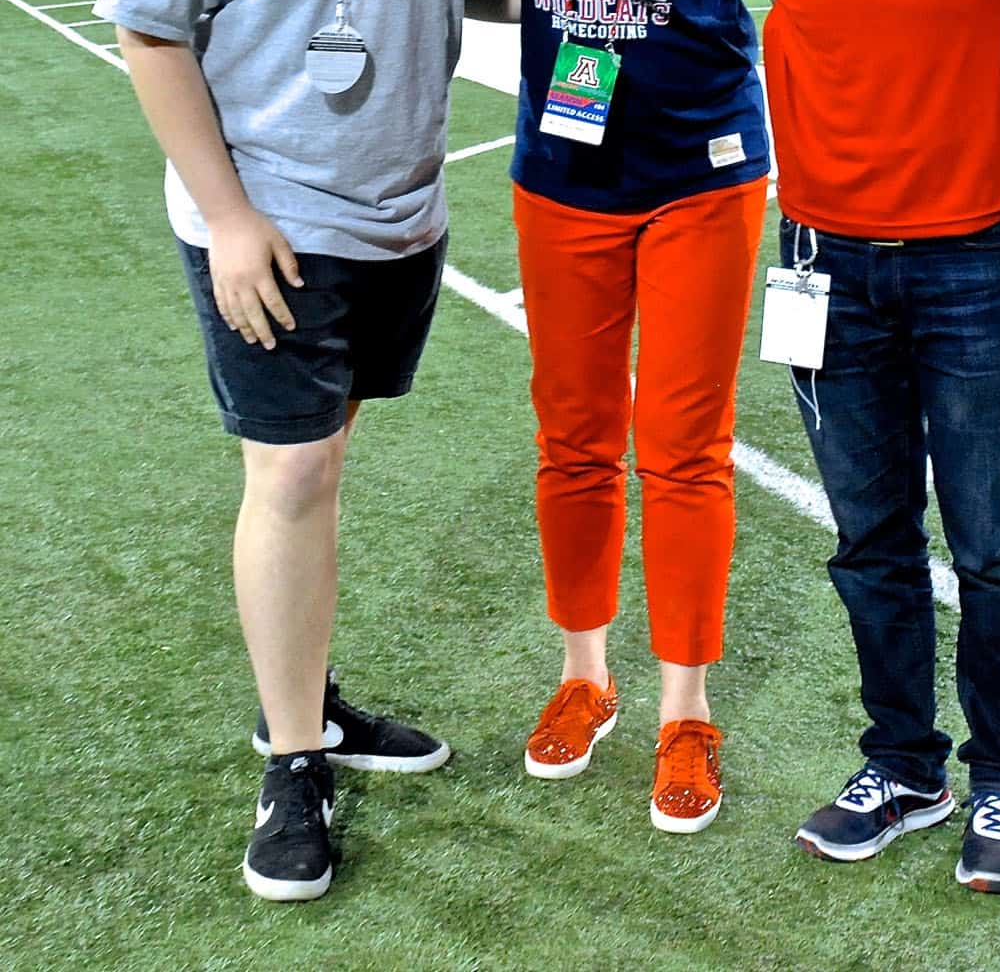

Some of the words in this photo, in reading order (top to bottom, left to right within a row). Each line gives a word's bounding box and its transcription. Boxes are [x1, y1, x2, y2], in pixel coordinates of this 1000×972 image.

[567, 55, 600, 88] A
[546, 103, 577, 116] LIMITED
[575, 110, 605, 123] ACCESS
